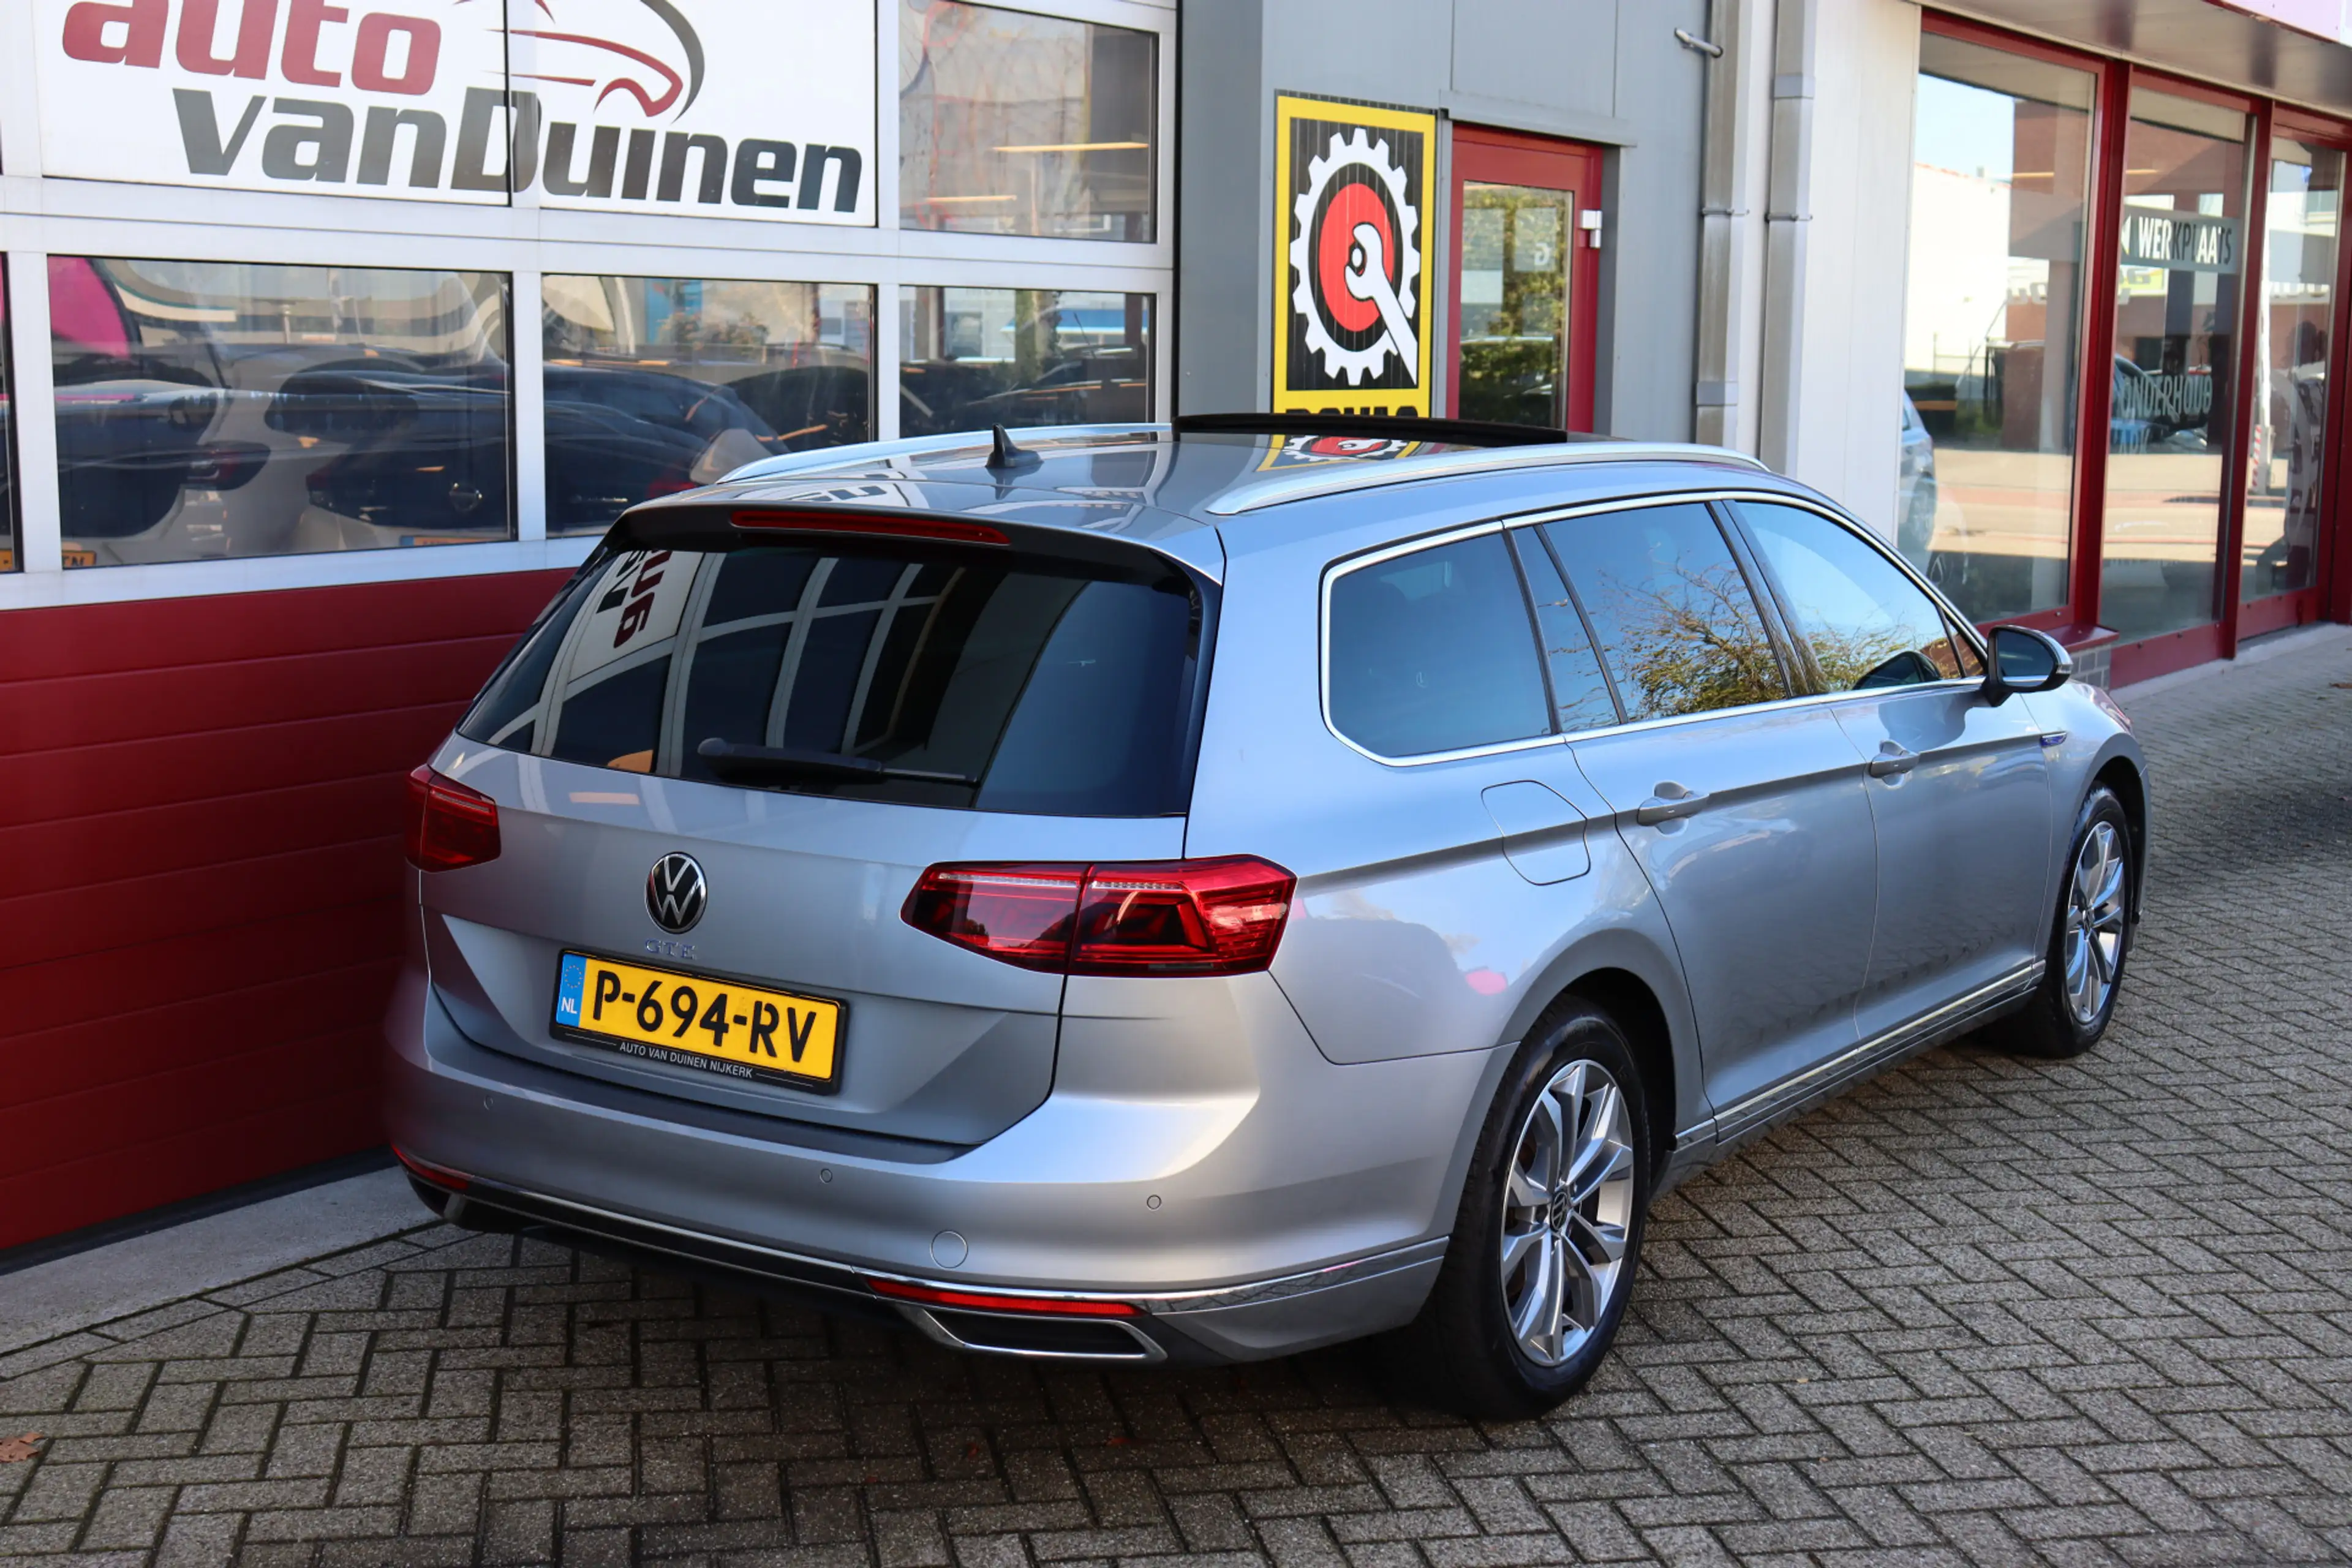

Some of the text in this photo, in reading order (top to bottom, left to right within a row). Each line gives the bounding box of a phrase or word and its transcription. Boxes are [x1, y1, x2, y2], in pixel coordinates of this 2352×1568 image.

[62, 0, 442, 96] auto
[172, 86, 862, 213] vanDuinen
[2138, 216, 2233, 266] WERKPLAATS
[644, 938, 697, 961] GTE
[560, 995, 578, 1016] NL
[592, 970, 816, 1063] P-694-RV
[619, 1041, 753, 1079] AUTO VAN DUINEN NIJKERK
